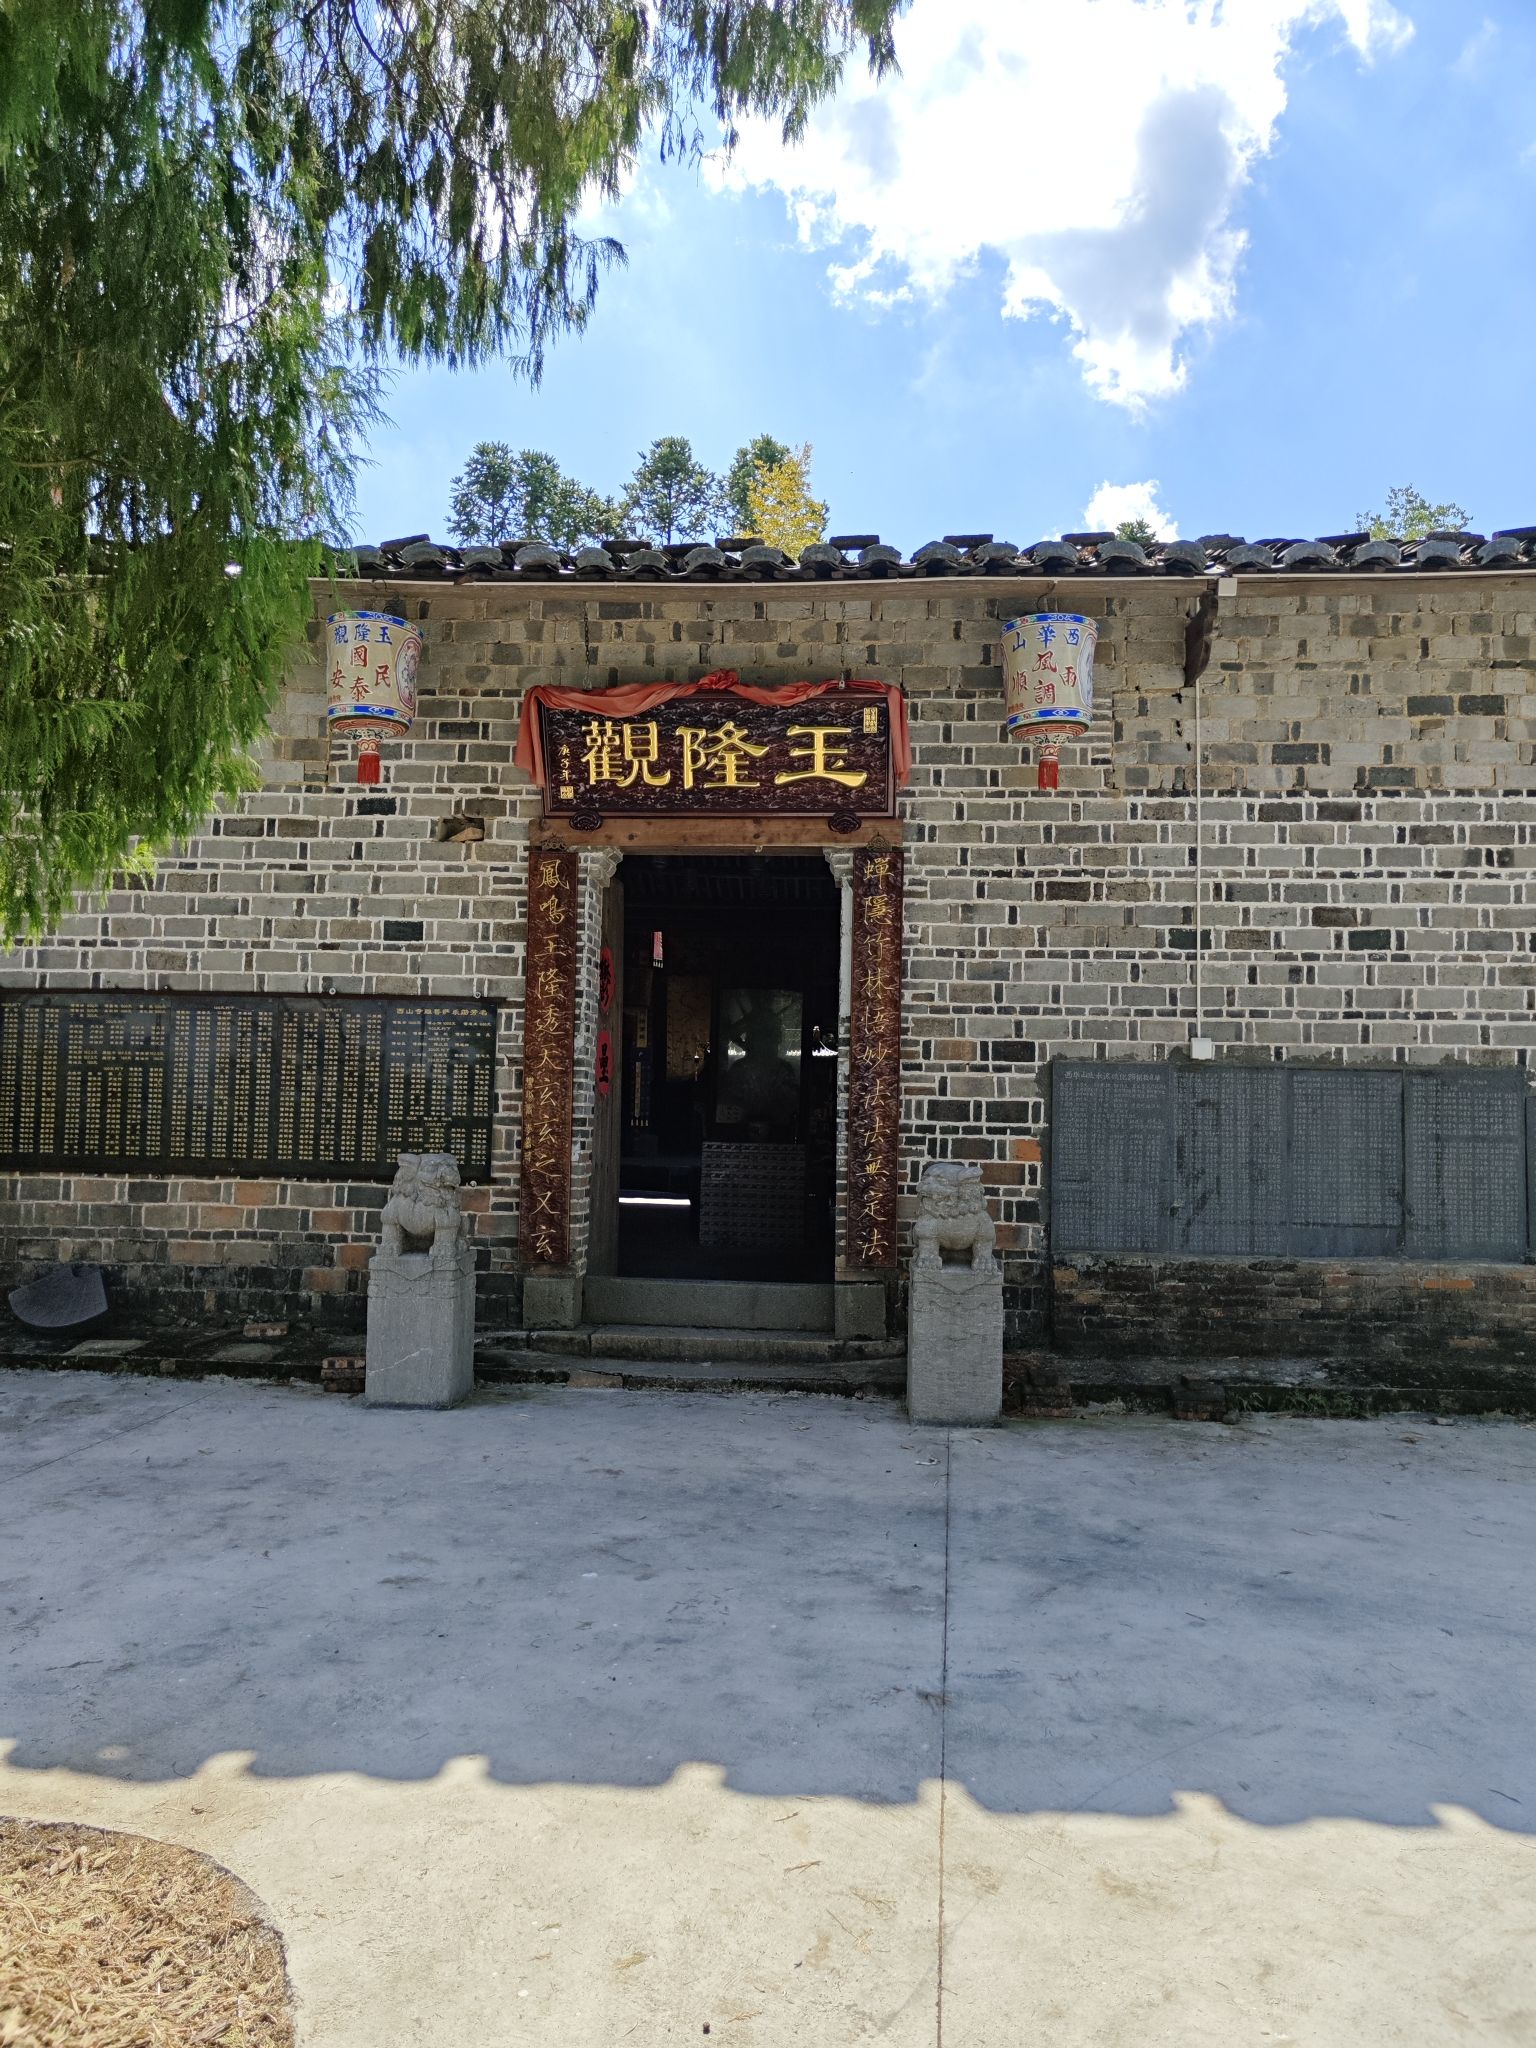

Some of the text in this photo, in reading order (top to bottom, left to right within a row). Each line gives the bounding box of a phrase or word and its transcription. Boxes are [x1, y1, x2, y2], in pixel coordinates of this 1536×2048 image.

[334, 623, 393, 645] 玉隆觀
[557, 744, 572, 782] 庚子年
[581, 720, 868, 790] 玉隆觀
